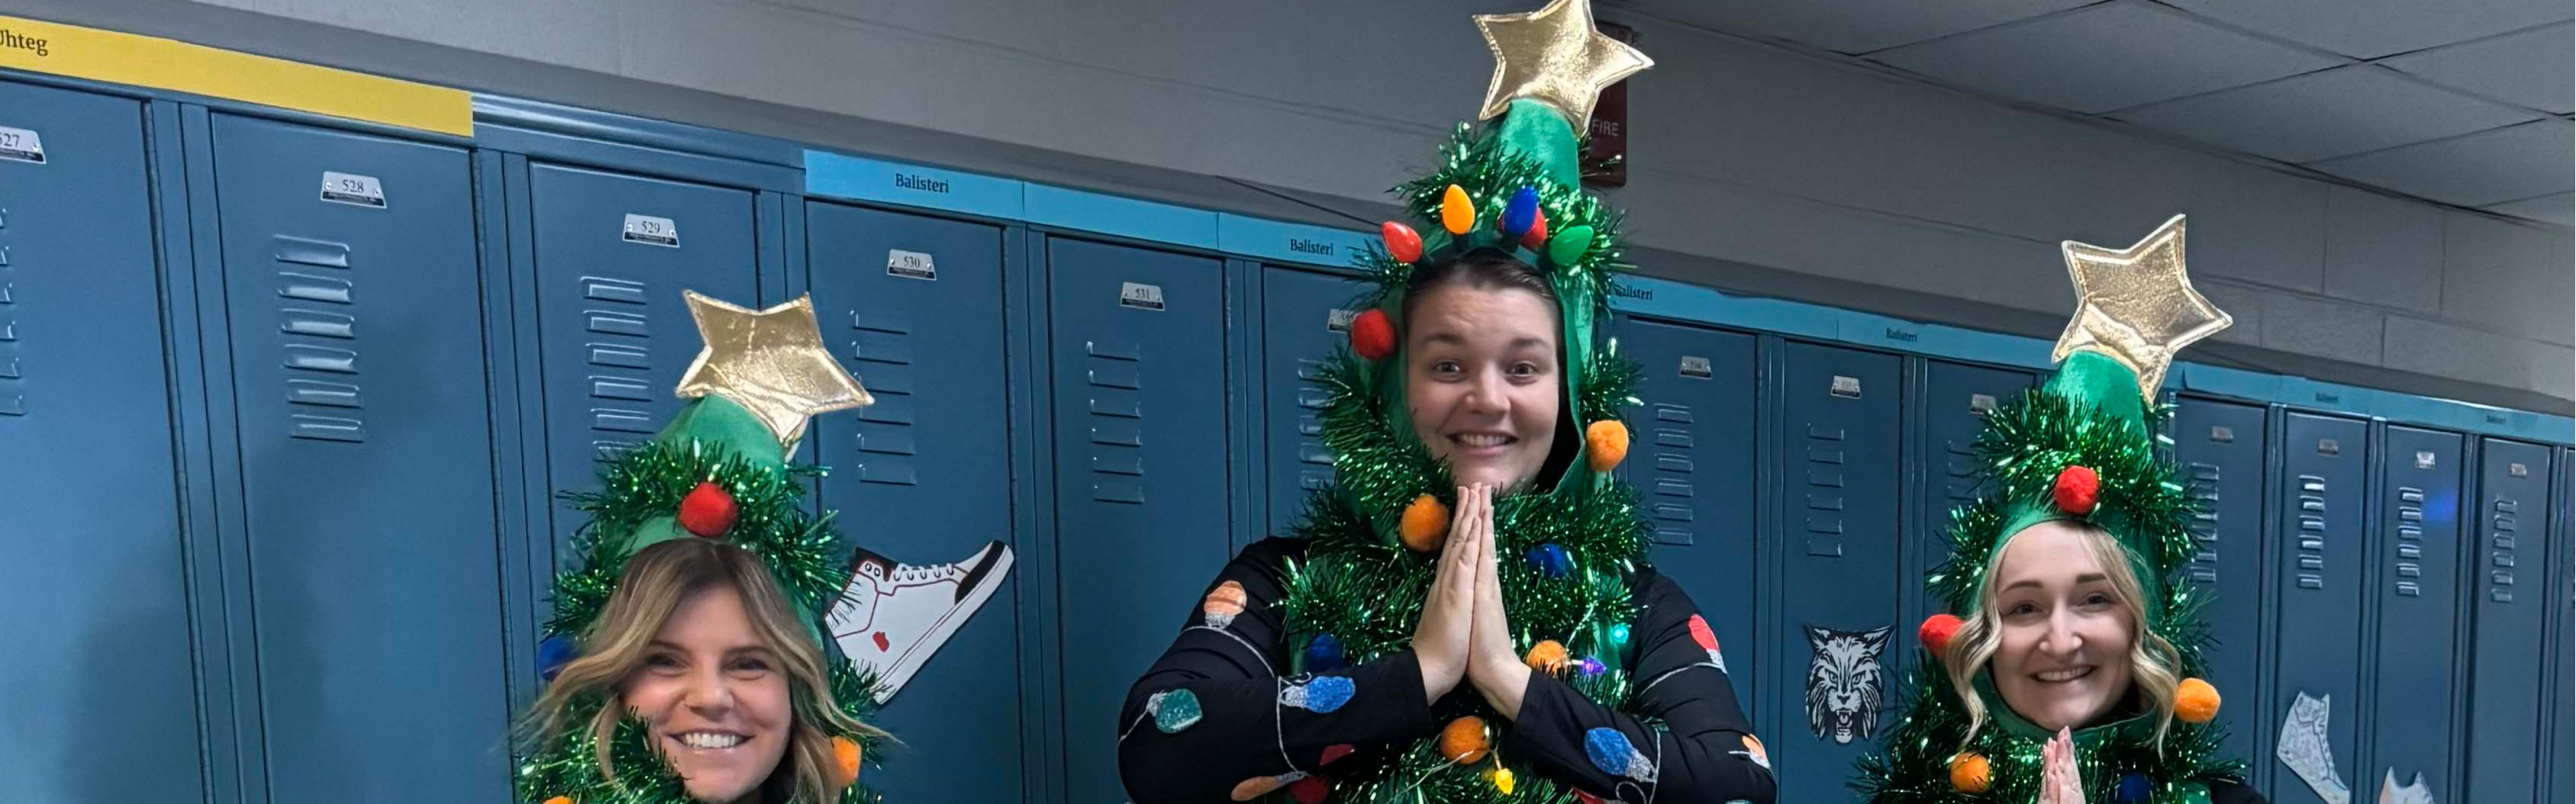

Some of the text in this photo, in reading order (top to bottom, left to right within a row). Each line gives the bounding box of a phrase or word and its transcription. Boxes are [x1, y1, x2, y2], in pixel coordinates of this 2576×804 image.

[1591, 118, 1619, 137] FIRE
[342, 179, 364, 193] 528
[895, 173, 949, 194] Balisteri
[642, 220, 660, 233] 529
[1290, 239, 1334, 256] Balisteri
[904, 256, 921, 268] 530
